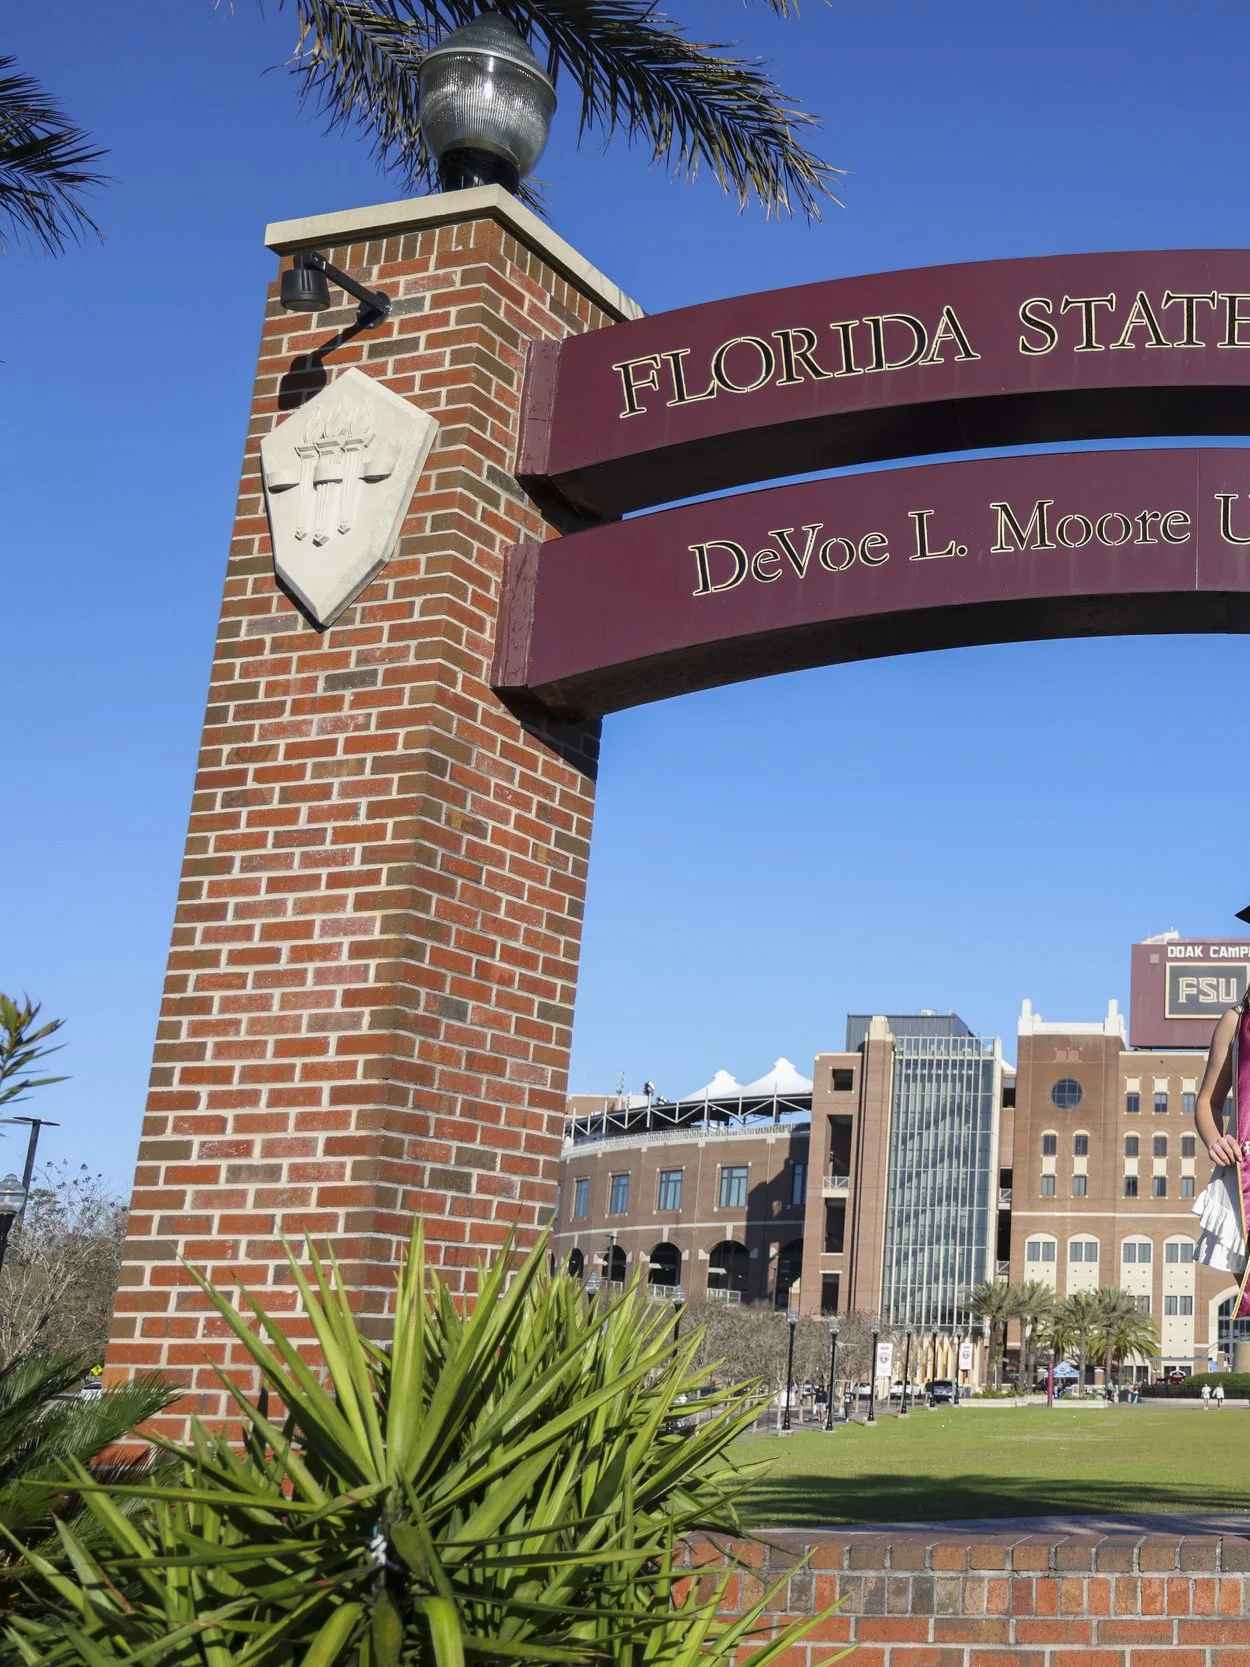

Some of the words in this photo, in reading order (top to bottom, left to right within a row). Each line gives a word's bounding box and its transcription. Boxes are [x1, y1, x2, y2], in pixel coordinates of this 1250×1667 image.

[612, 305, 981, 418] FLORIDA
[688, 523, 890, 597] DeVoe
[908, 509, 968, 561] L.
[989, 500, 1192, 554] Moore
[1167, 945, 1204, 958] DOAK
[1178, 977, 1237, 1003] FSU
